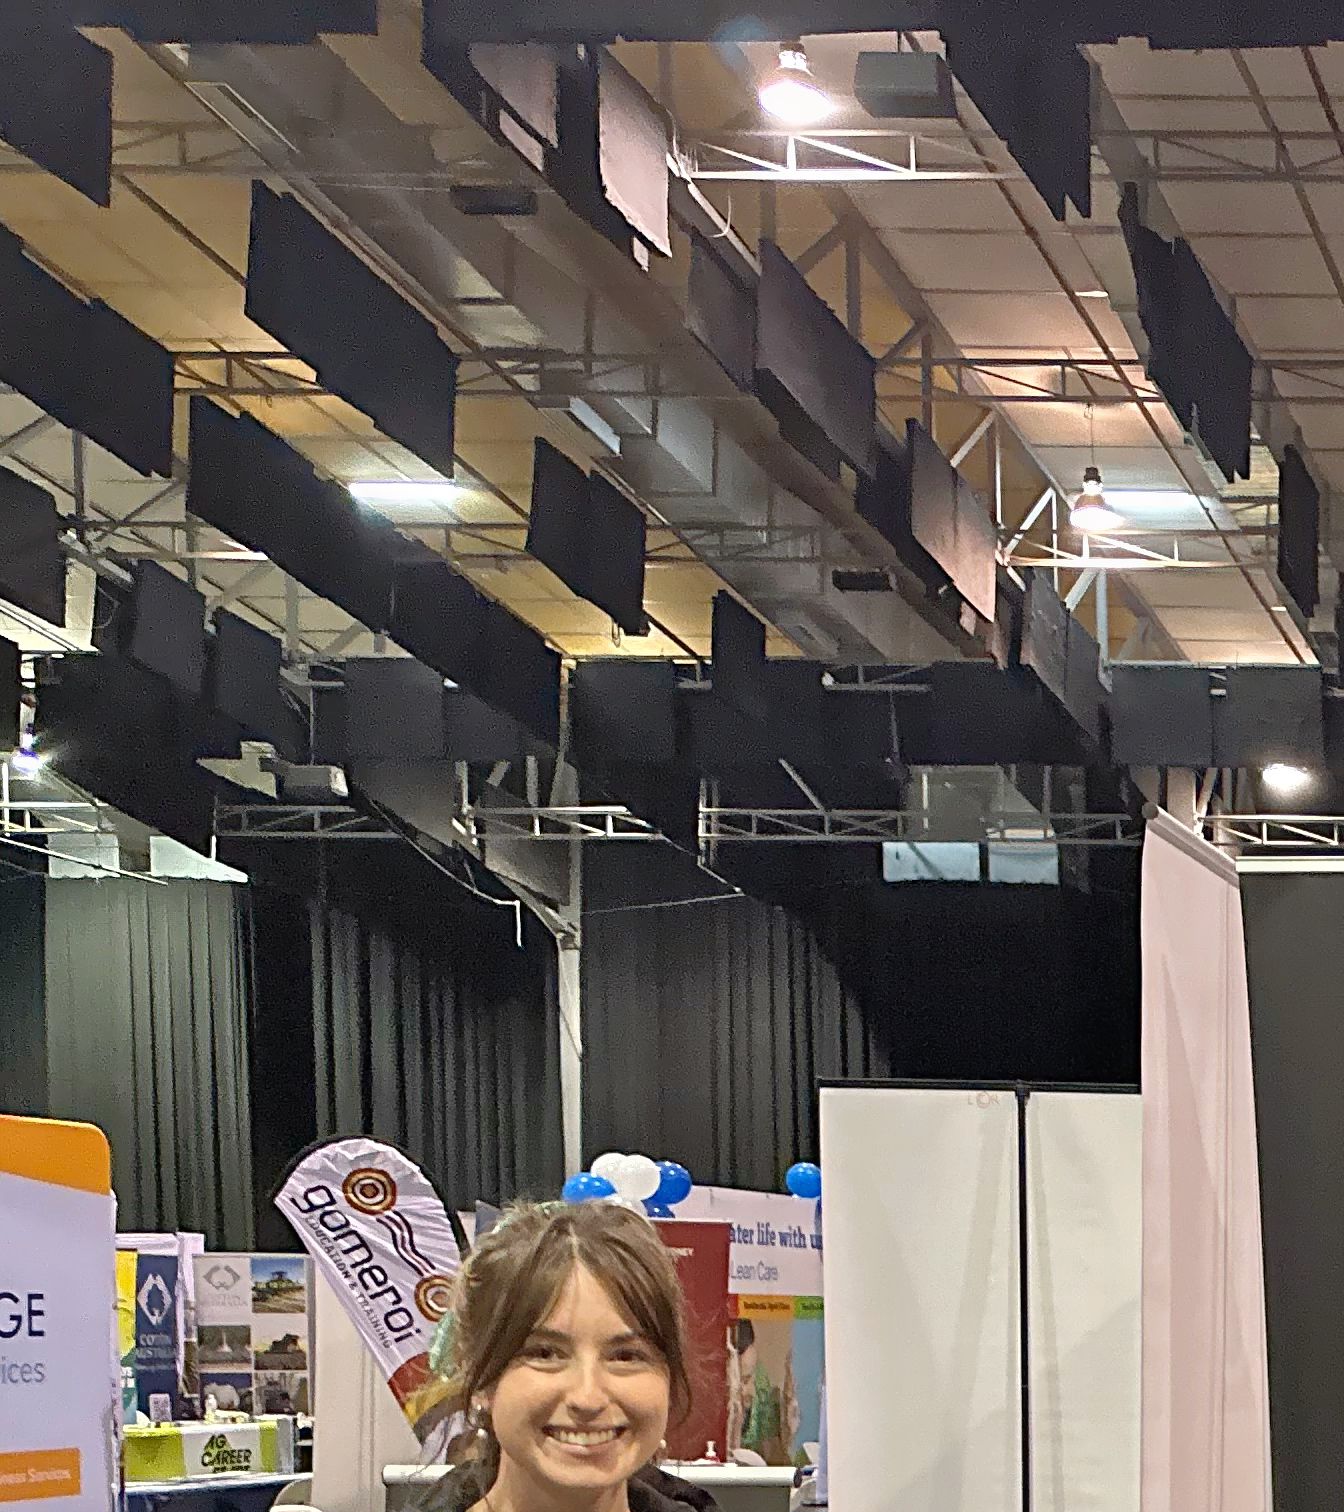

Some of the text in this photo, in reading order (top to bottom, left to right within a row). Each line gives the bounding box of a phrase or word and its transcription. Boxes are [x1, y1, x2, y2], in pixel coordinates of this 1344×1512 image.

[290, 1185, 422, 1343] gomeroi
[305, 1216, 393, 1349] EDUCATION TRAINING
[201, 1450, 252, 1467] CAREER
